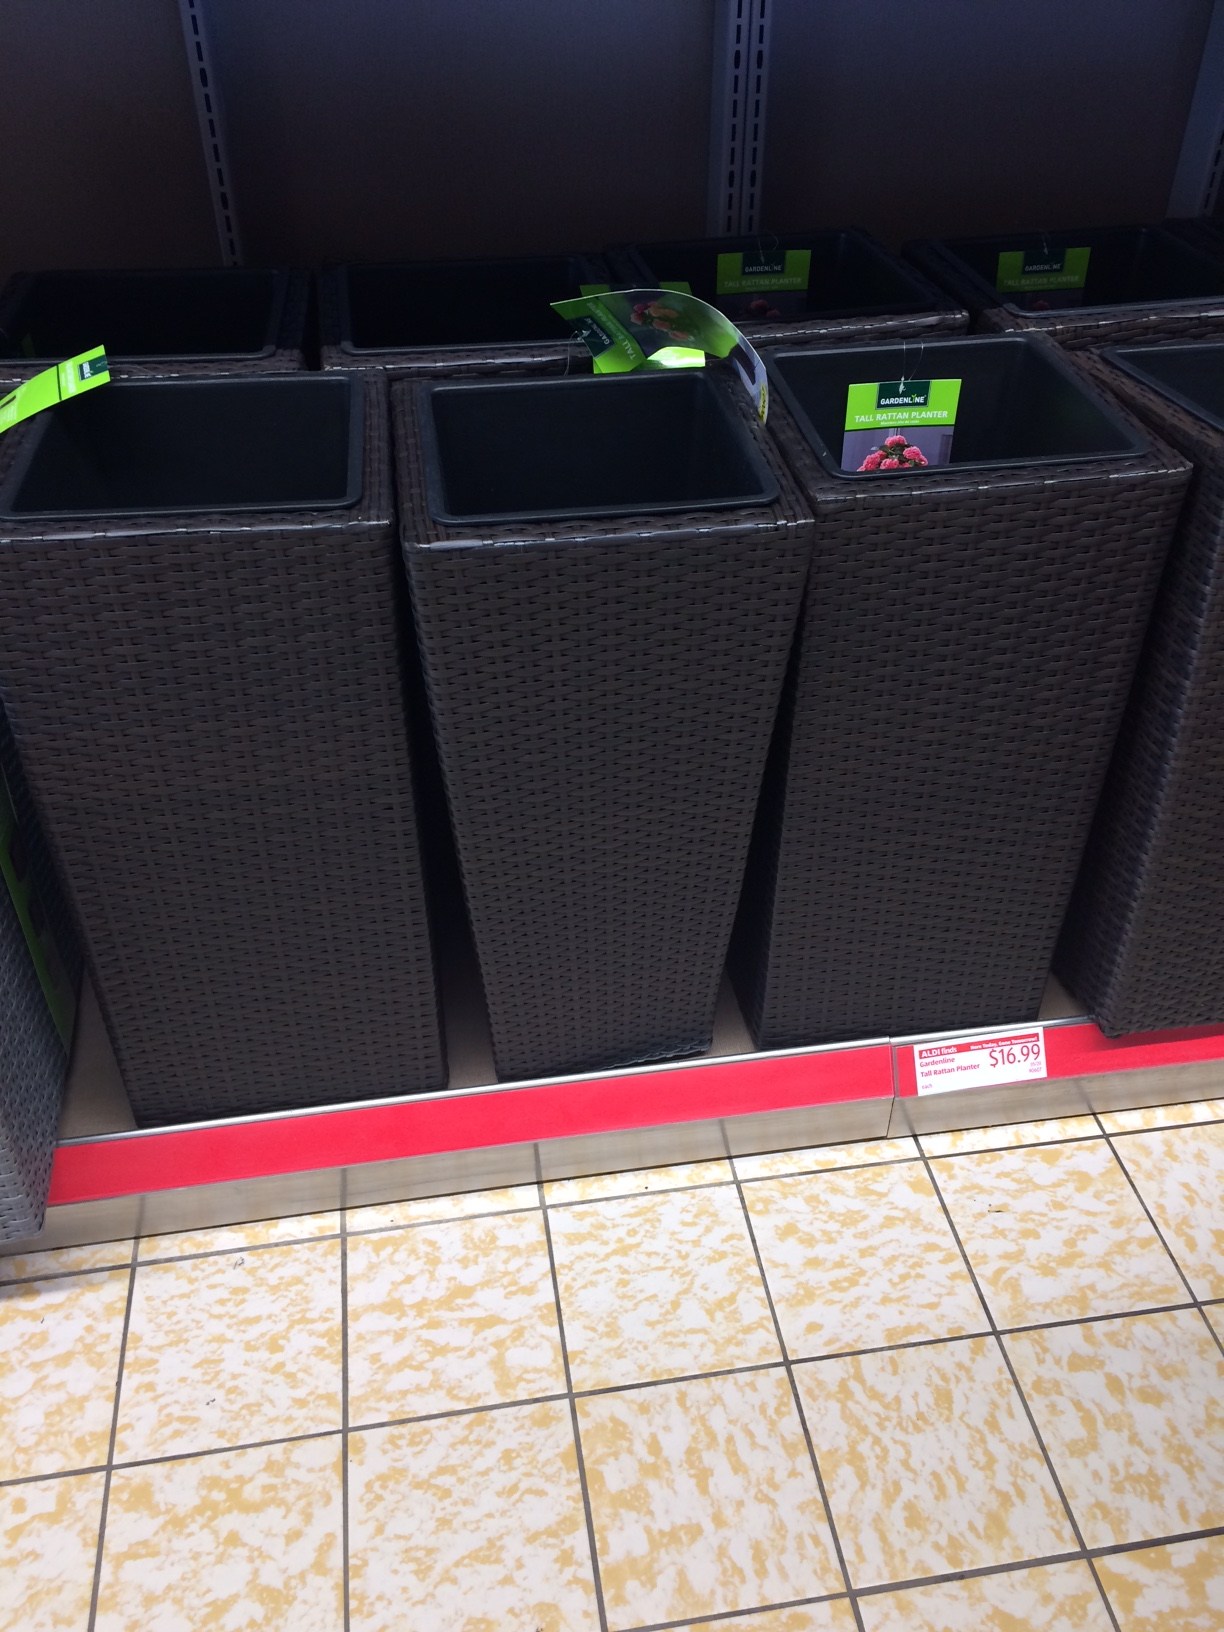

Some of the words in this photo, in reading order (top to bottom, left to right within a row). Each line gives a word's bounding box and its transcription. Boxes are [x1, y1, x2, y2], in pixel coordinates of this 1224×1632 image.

[880, 395, 925, 405] GARDENLINE
[854, 414, 874, 423] TALL
[876, 412, 908, 421] RATTAN
[911, 410, 948, 419] PLANTER
[921, 1049, 941, 1058] ALDI
[941, 1046, 957, 1054] finds
[989, 1043, 1041, 1068] $16.99
[920, 1057, 956, 1067] Gardenline
[933, 1067, 955, 1076] Rattan
[956, 1064, 980, 1072] Planter
